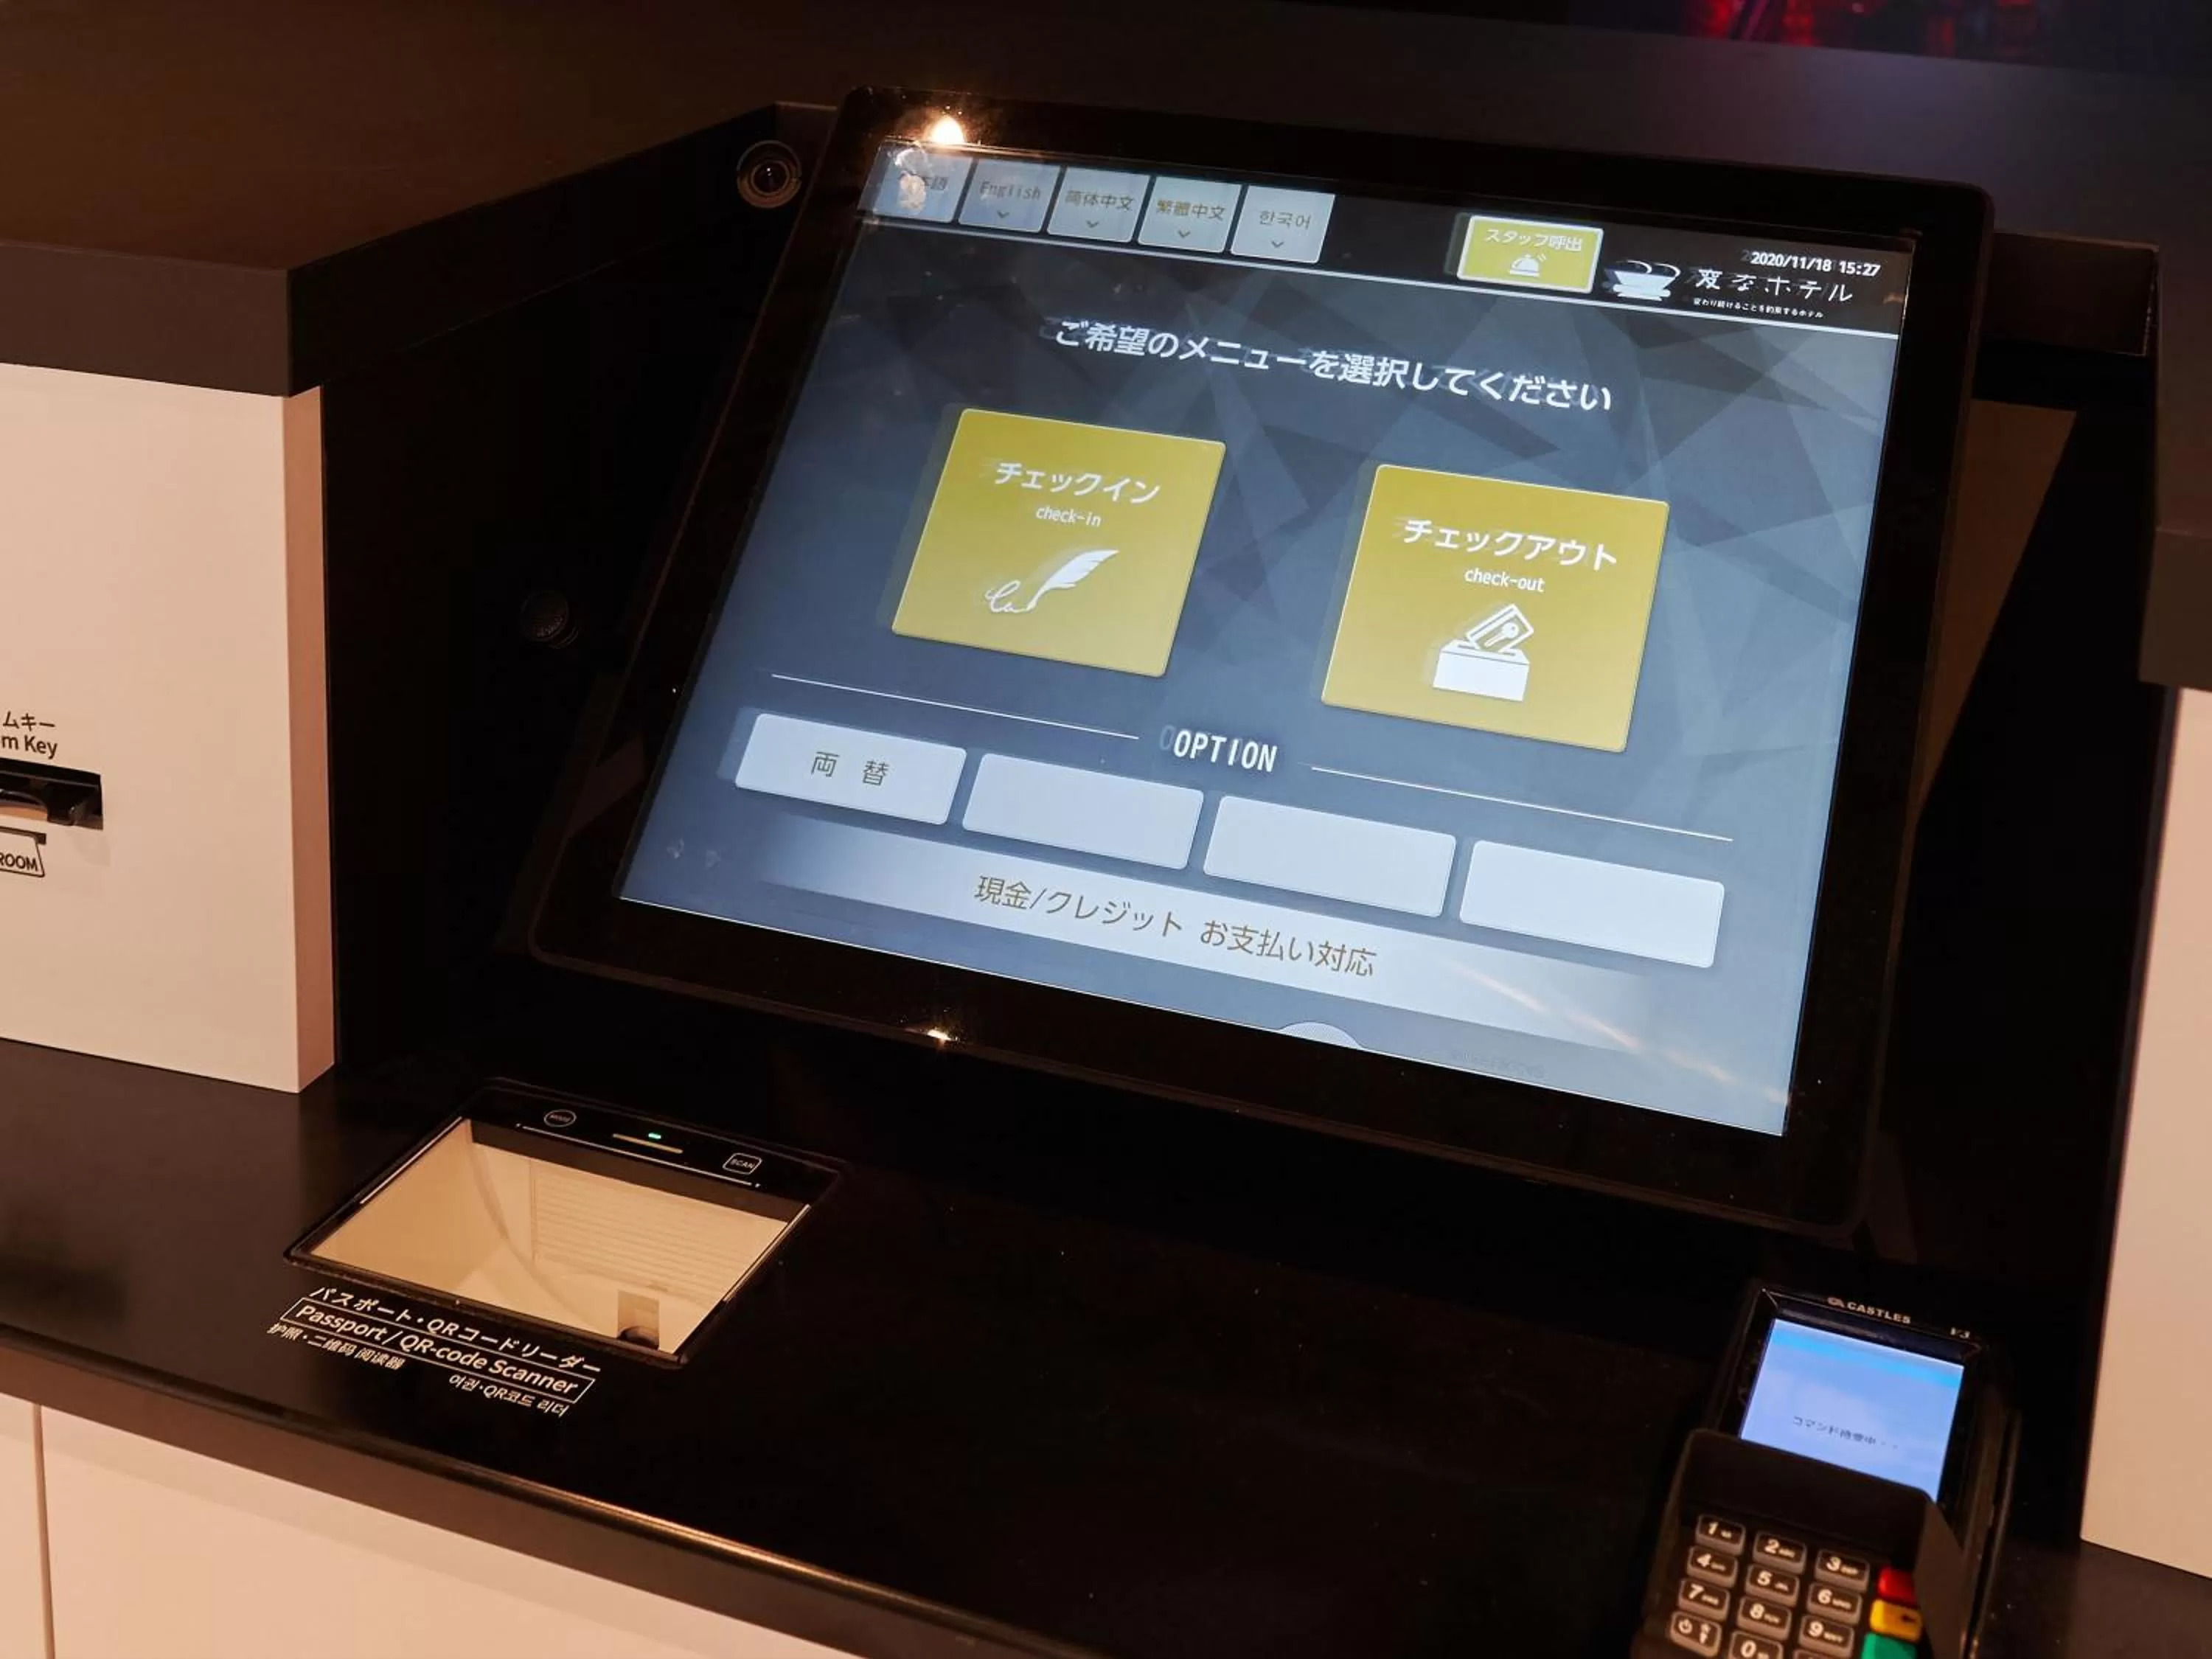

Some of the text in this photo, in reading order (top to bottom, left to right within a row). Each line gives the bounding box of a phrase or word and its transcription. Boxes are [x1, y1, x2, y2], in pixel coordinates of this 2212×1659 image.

[980, 181, 1040, 201] English
[1065, 189, 1133, 212] 简体中文
[1259, 209, 1312, 230] 한국어
[1484, 229, 1583, 251] スタッフ呼出
[1750, 251, 1881, 276] 2020/11/18 15:27
[1055, 319, 1613, 411] ご希望のメニューを選択してください
[995, 462, 1161, 504] チェックイン
[1036, 506, 1102, 526] check-in
[1403, 518, 1617, 571] チェックアウト
[1464, 567, 1545, 593] check-out
[24, 734, 58, 759] Key
[1173, 728, 1278, 773] OPTION
[974, 874, 1377, 978] 現金/クレジット お支払い対応
[1847, 1301, 1911, 1324] CASTLES
[296, 1304, 387, 1342] Passport
[400, 1334, 487, 1370] QR-code
[488, 1359, 579, 1394] Scanner
[1708, 1522, 1719, 1534] 1
[1764, 1538, 1780, 1554] 2
[1697, 1554, 1711, 1568] 4
[1826, 1557, 1841, 1571] 3
[1757, 1571, 1773, 1585] 5
[1688, 1584, 1704, 1599] 7
[1817, 1588, 1832, 1604] 6
[1749, 1603, 1765, 1620] 8
[1807, 1621, 1823, 1638] 9
[1740, 1640, 1756, 1658] 0
